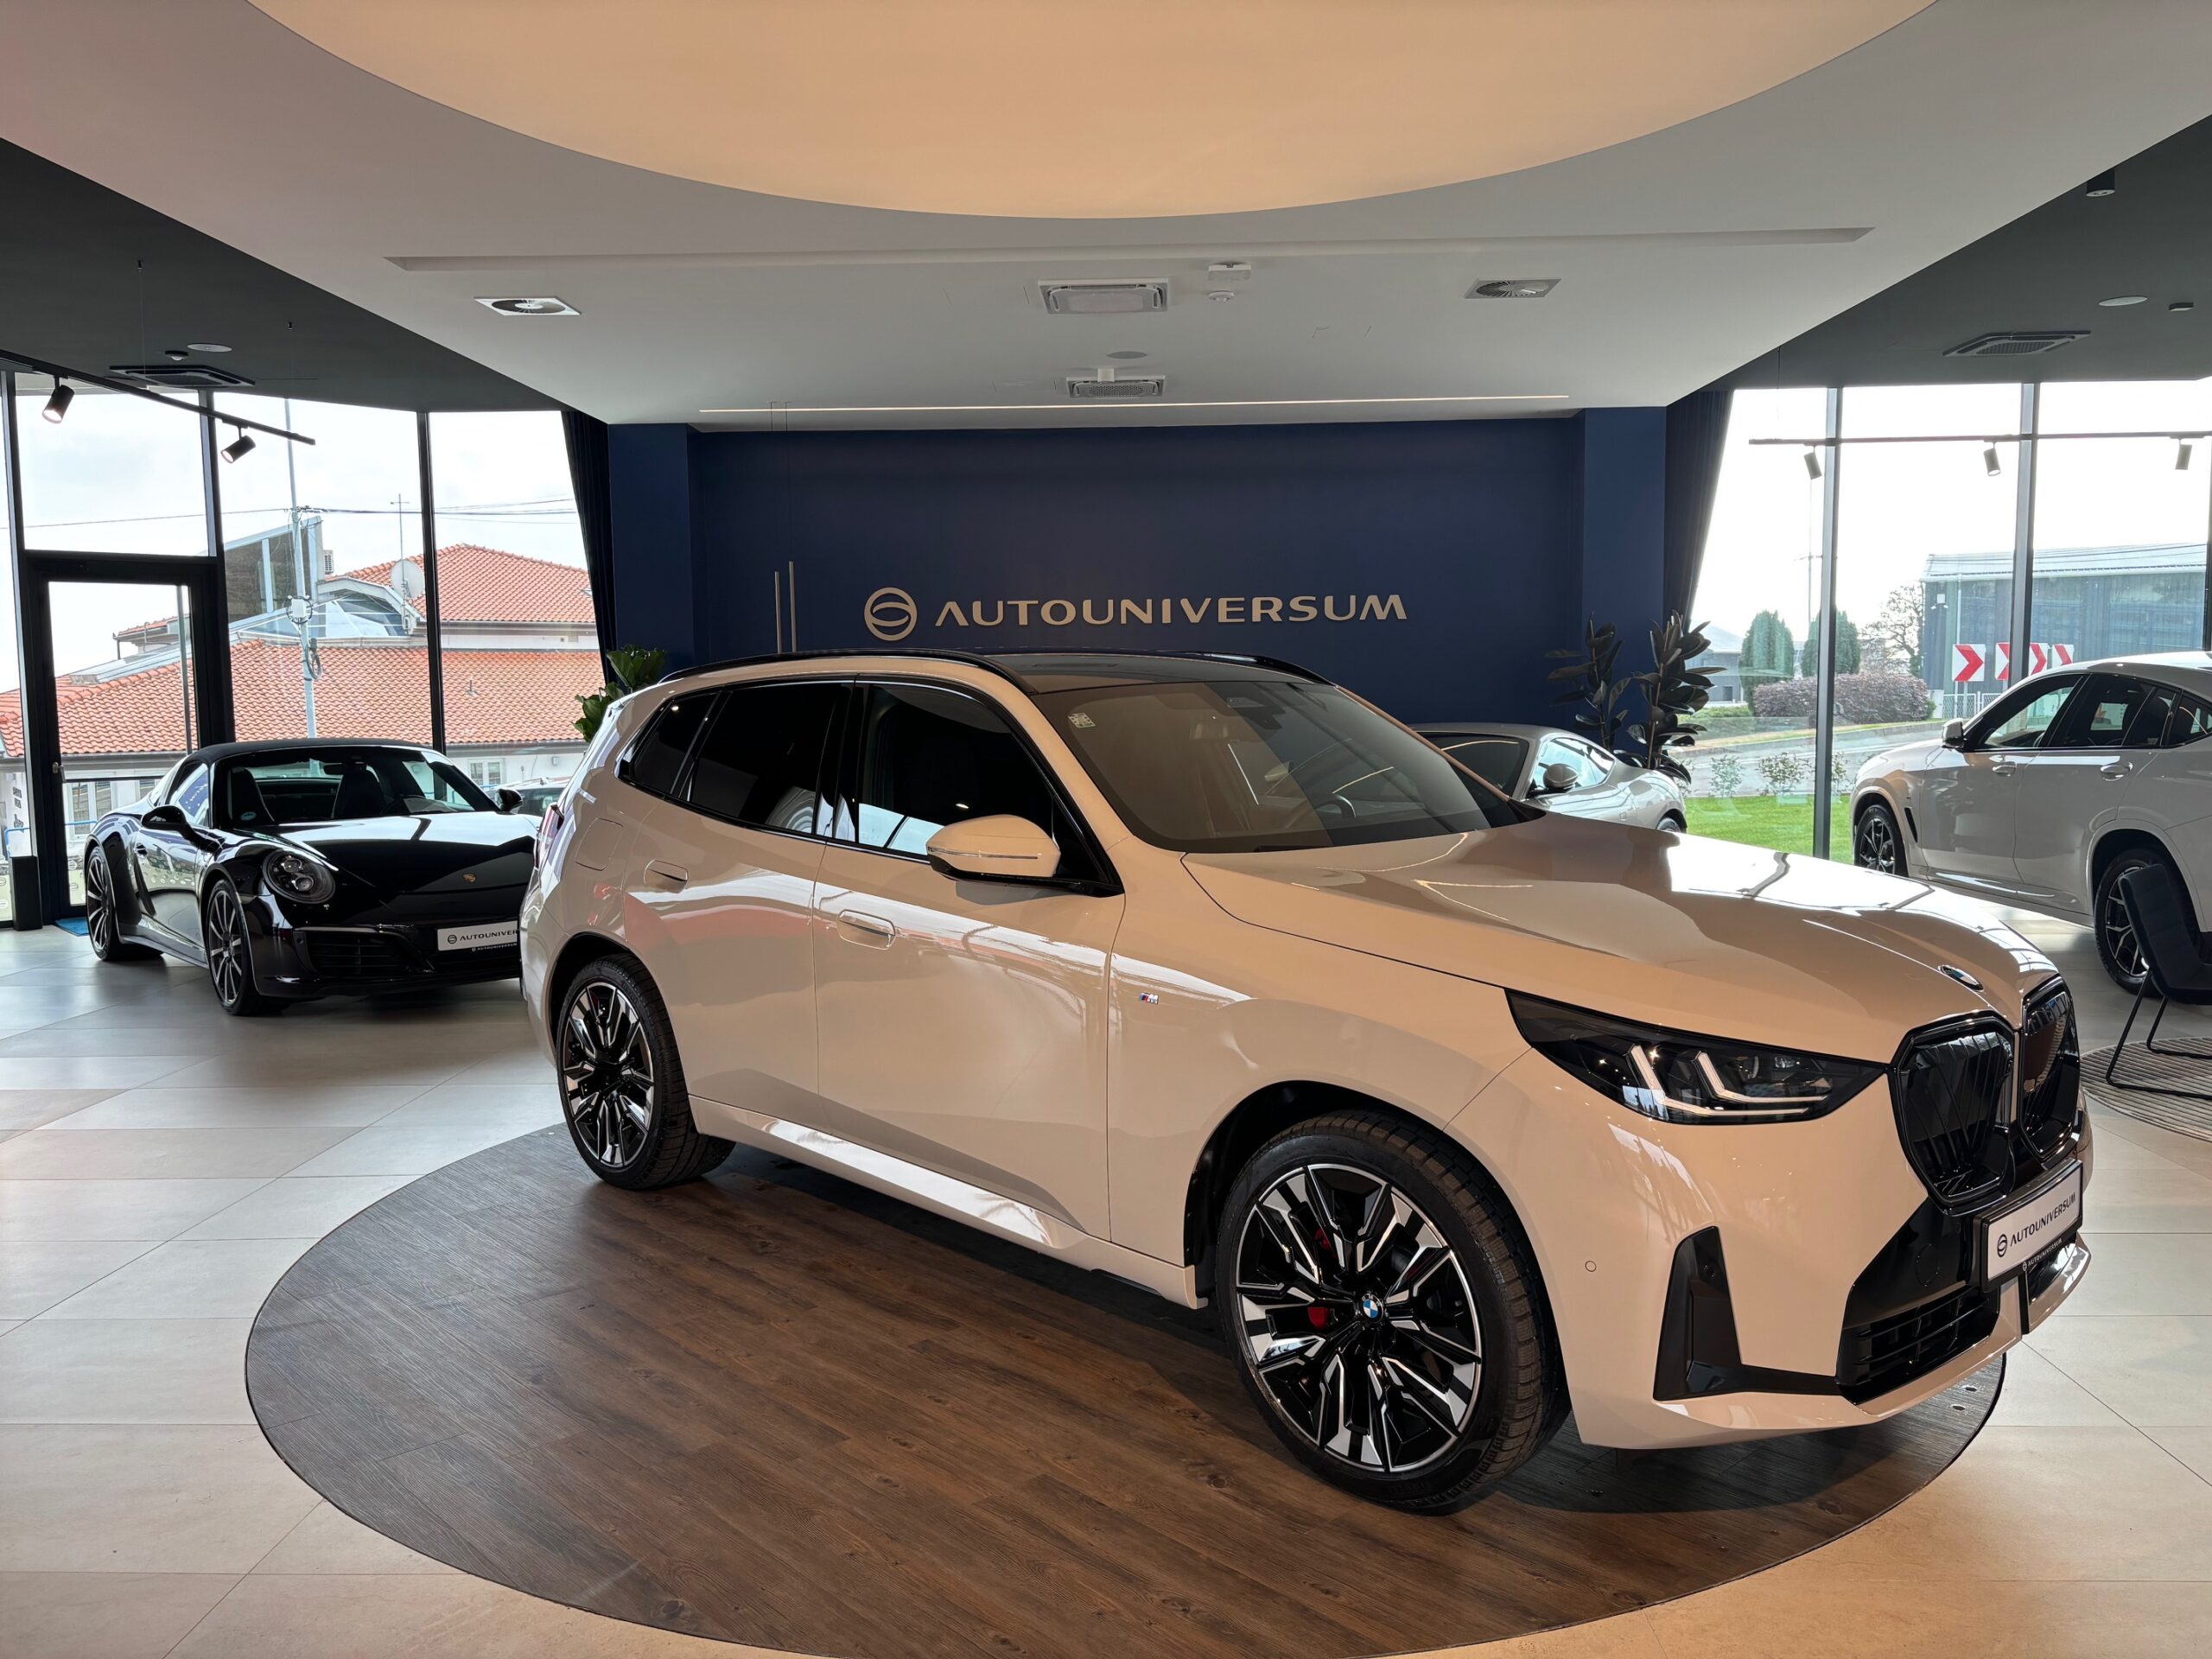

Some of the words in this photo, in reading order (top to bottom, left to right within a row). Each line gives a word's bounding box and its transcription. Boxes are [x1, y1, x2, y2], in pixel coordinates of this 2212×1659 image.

[934, 593, 1408, 627] AUTOUNIVERSUM
[2010, 1192, 2076, 1247] AUTOUNIVERSUM
[2027, 1238, 2063, 1267] AUTOUNIVERSUM
